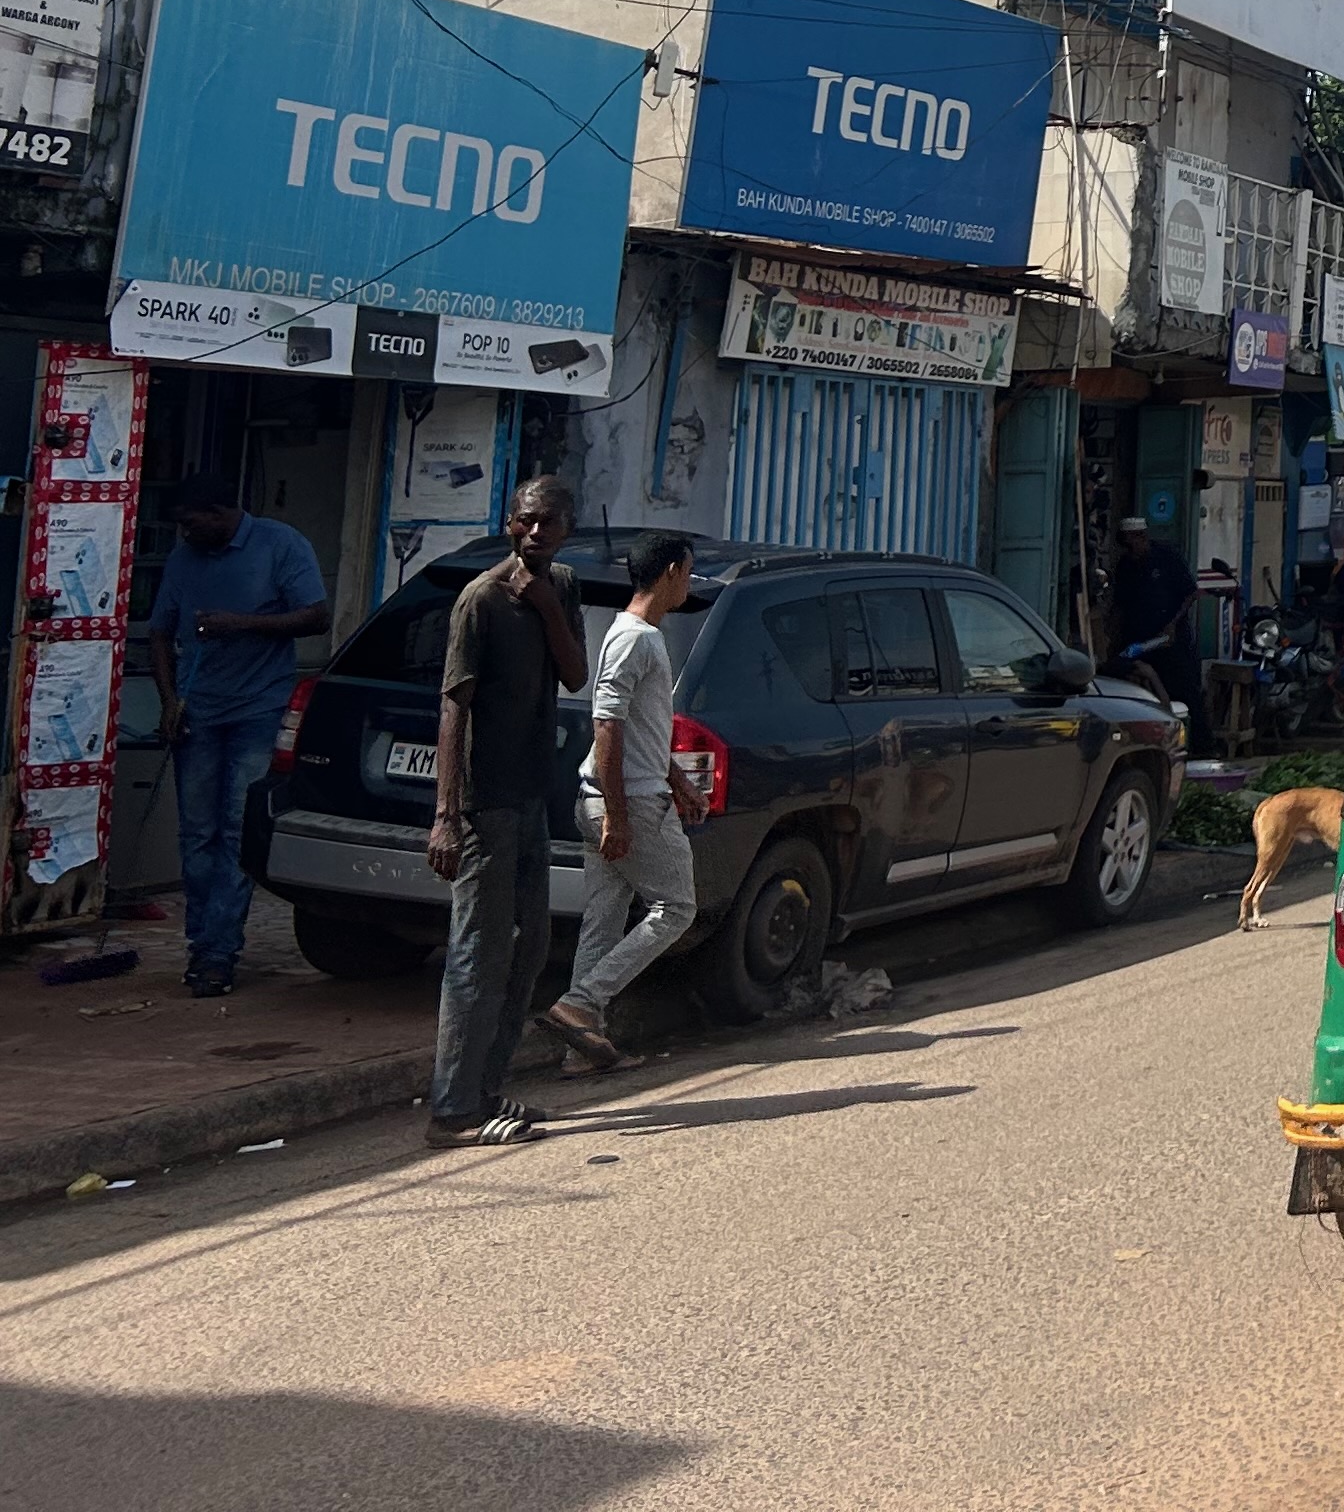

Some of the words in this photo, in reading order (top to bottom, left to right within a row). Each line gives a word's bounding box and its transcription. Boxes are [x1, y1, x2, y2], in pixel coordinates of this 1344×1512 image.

[2, 7, 38, 24] WARGA
[807, 66, 971, 160] TECNO
[276, 98, 547, 224] TECNO
[737, 188, 766, 209] BAH
[767, 192, 812, 217] KUNDA
[814, 200, 861, 224] MOBILE
[863, 207, 896, 228] SHOP
[904, 214, 947, 235] 7400147
[1166, 245, 1205, 272] MOBILE
[169, 256, 222, 288] MKJ
[230, 264, 324, 298] MOBILE
[330, 277, 395, 307] SHOP
[412, 287, 496, 320] 2667609
[512, 300, 584, 329] 3829213
[748, 257, 800, 287] BAH
[803, 266, 881, 300] KUNDA
[882, 278, 959, 312] MOBILE
[961, 292, 1010, 318] SHOP
[137, 298, 202, 323] SPARK
[208, 305, 230, 326] 40
[368, 333, 425, 356] TECNO
[462, 333, 492, 351] POP
[497, 337, 510, 354] 10
[765, 345, 798, 361] +220
[802, 347, 857, 368] 7400147
[867, 356, 920, 376] 3065502
[422, 442, 457, 452] SPARK
